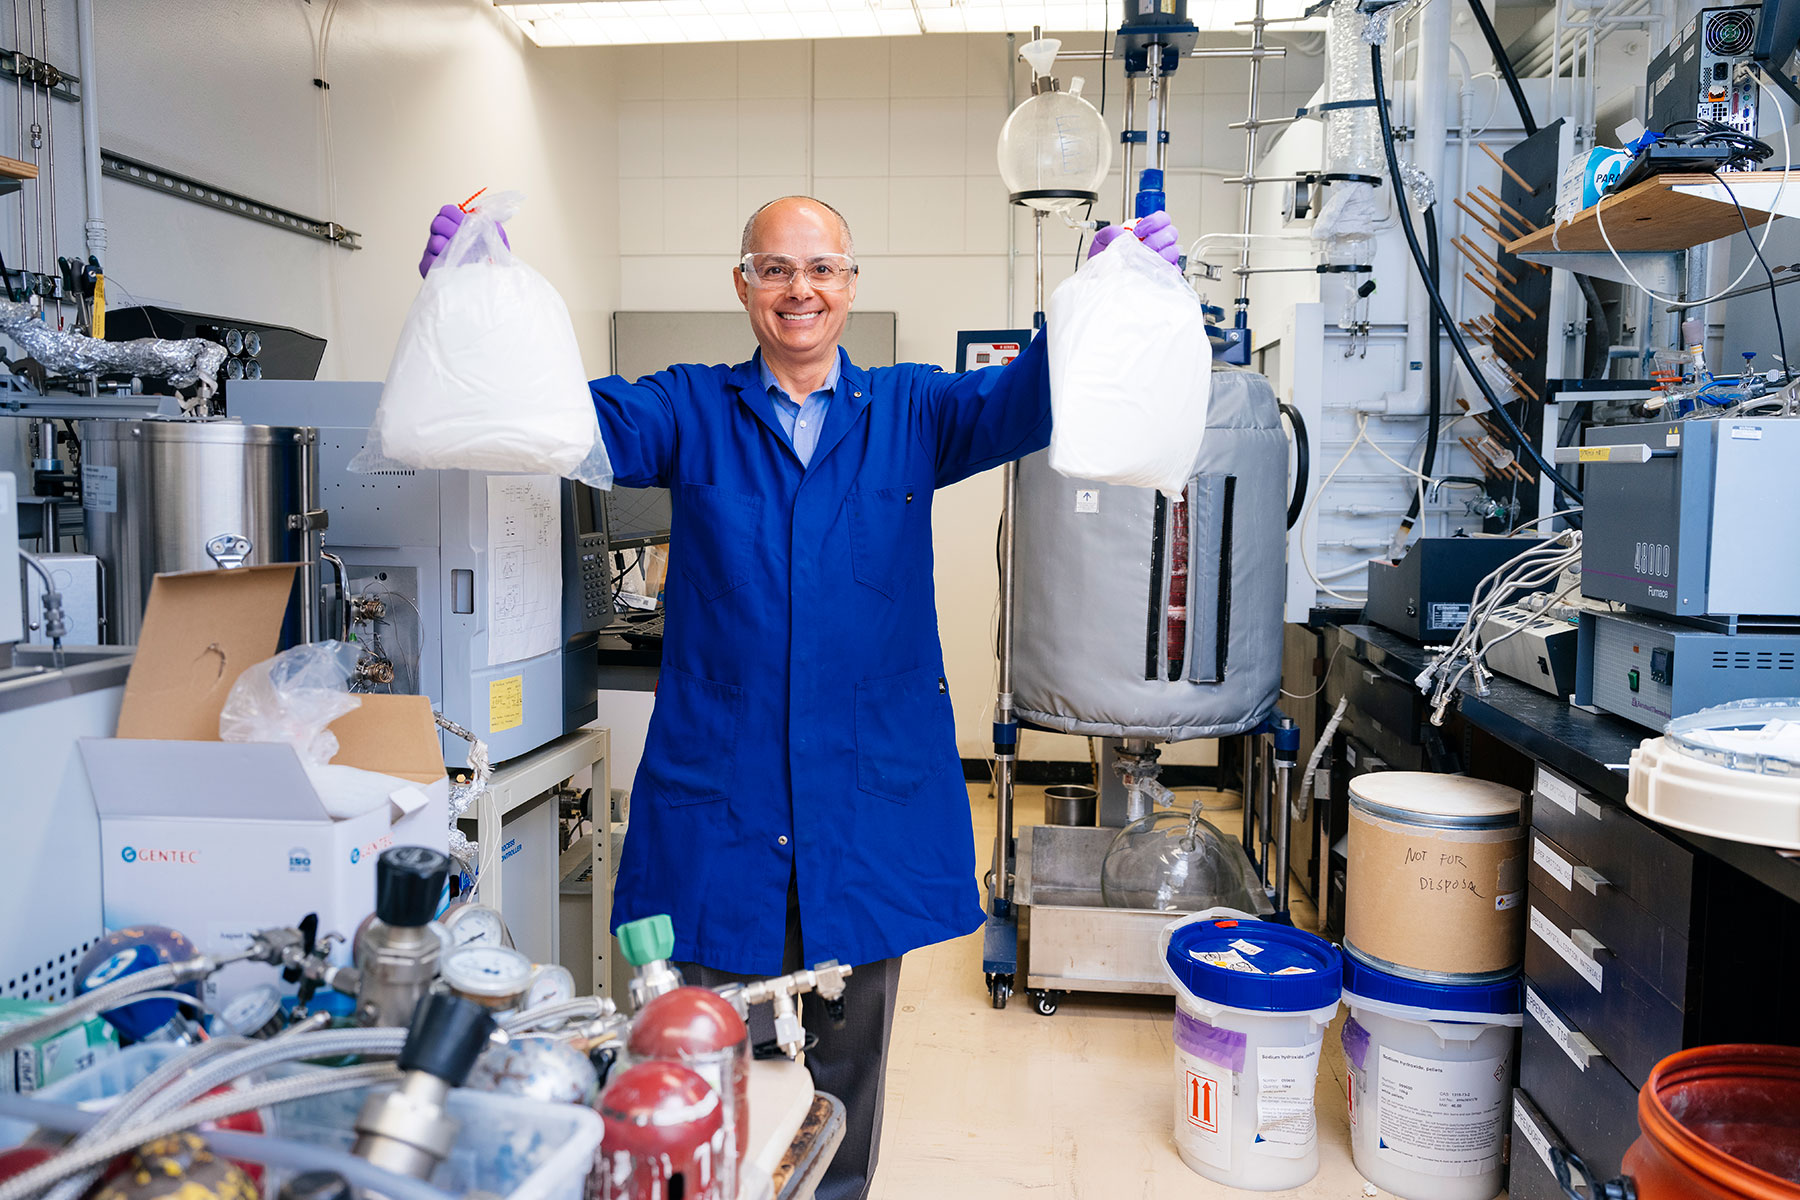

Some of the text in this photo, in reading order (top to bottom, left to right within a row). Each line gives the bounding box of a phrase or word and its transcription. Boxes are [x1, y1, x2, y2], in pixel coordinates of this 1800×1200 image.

[1634, 542, 1670, 578] 48000
[1648, 585, 1669, 599] Furnace
[138, 848, 198, 864] GENTEC
[289, 856, 311, 867] ISO
[1405, 847, 1467, 868] NOT FOR
